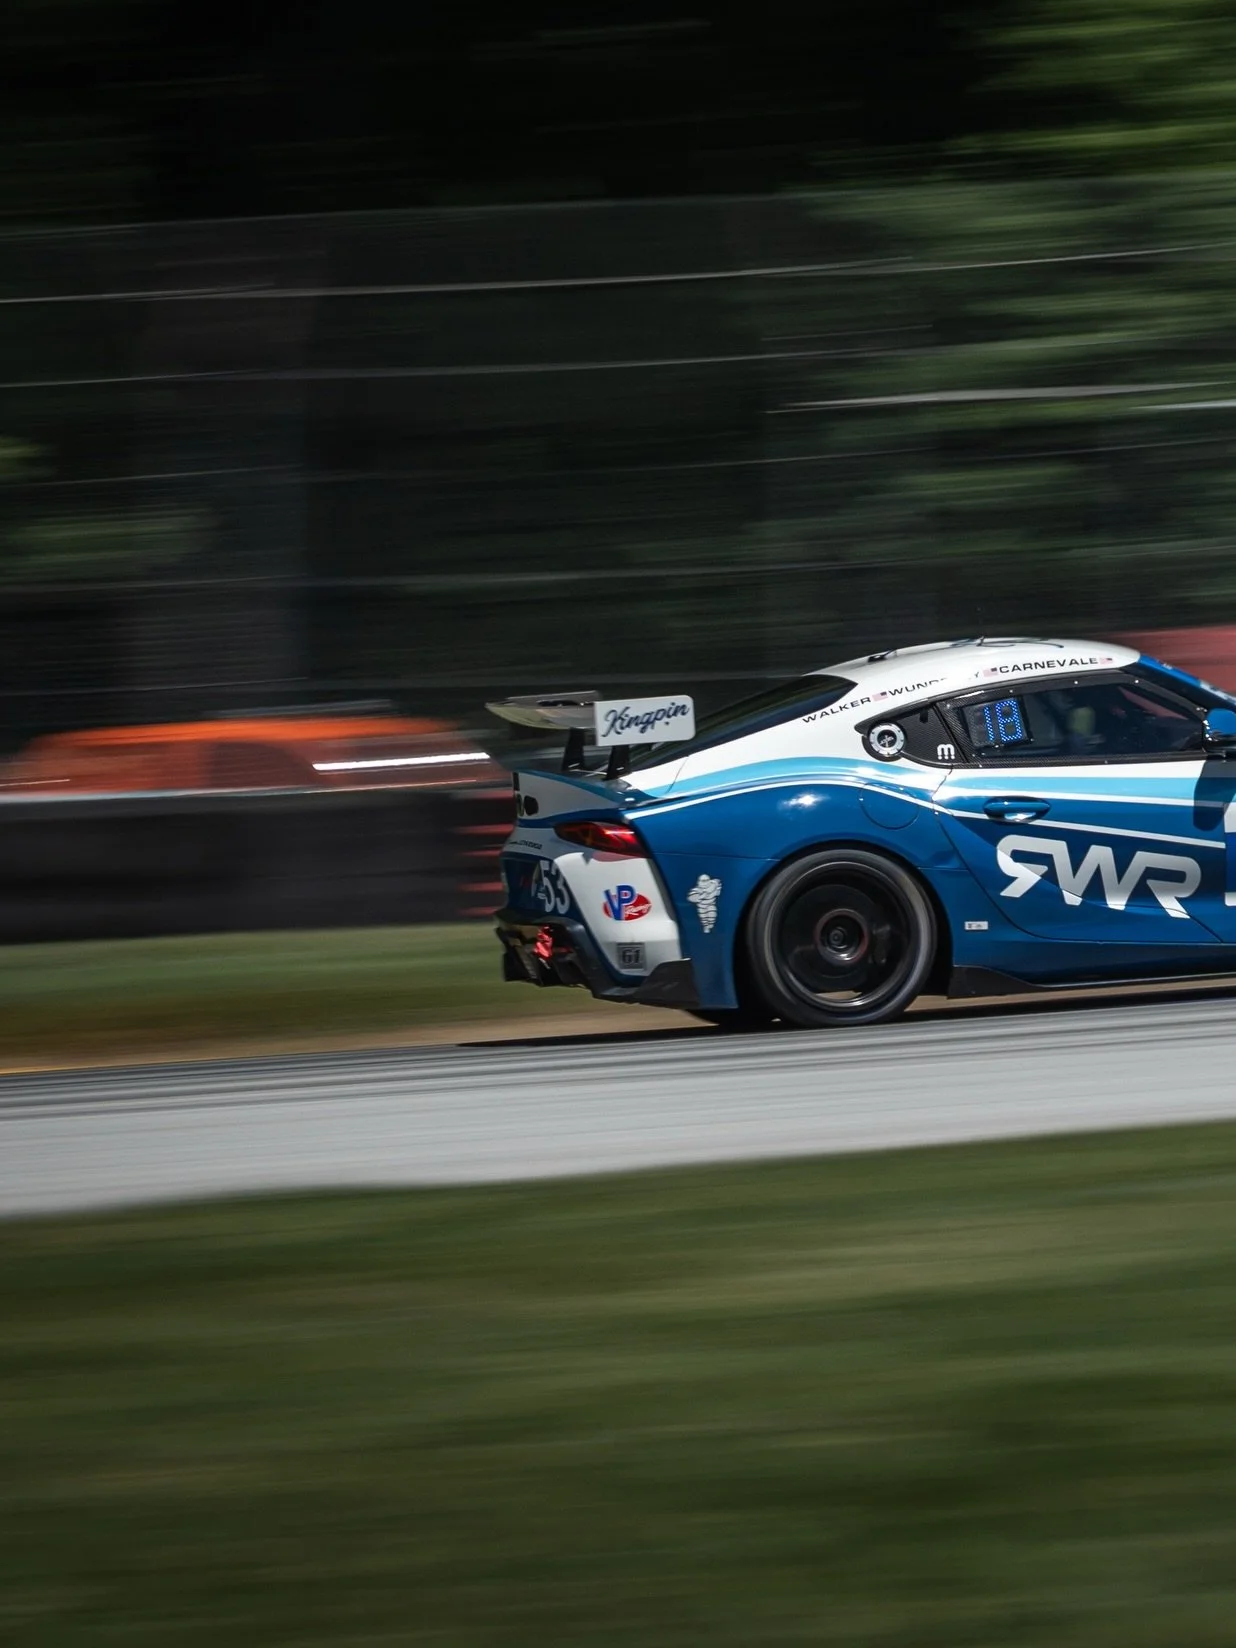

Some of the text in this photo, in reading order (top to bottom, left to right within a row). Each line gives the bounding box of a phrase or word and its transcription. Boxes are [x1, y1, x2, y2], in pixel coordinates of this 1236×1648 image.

[999, 657, 1099, 674] CARNEVALE
[601, 701, 690, 738] Kingpin
[802, 696, 872, 724] WALKER
[983, 700, 1023, 742] 18
[537, 859, 571, 915] 53
[603, 884, 637, 921] VP
